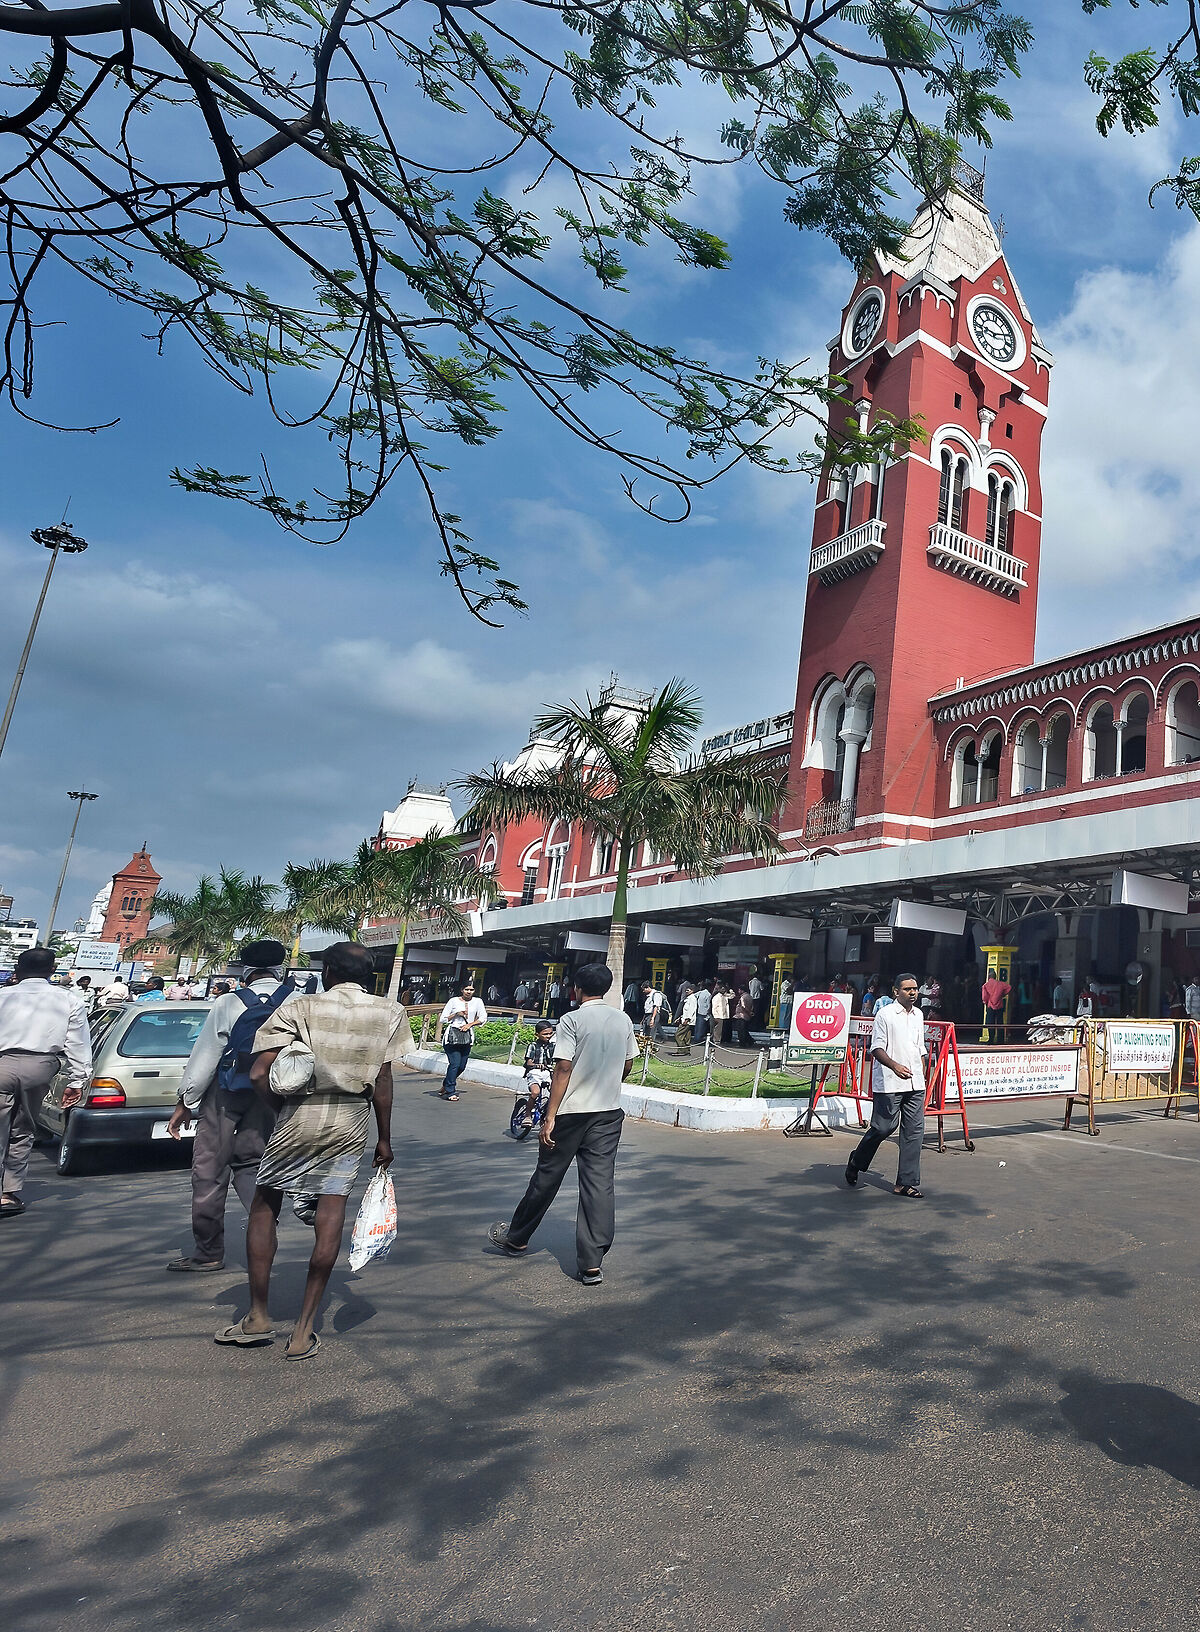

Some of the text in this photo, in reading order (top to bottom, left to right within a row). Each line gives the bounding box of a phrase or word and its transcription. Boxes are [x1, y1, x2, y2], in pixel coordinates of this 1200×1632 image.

[805, 999, 840, 1010] DROP
[807, 1014, 835, 1024] AND
[857, 1022, 873, 1034] Happ
[810, 1029, 829, 1039] GO
[1112, 1032, 1171, 1046] VIP ALIGHTING POINT
[969, 1054, 1053, 1065] FOR SECURITY PURPOSE
[947, 1064, 1071, 1077] VEICLES ARE NOT ALLOWED INSIDE
